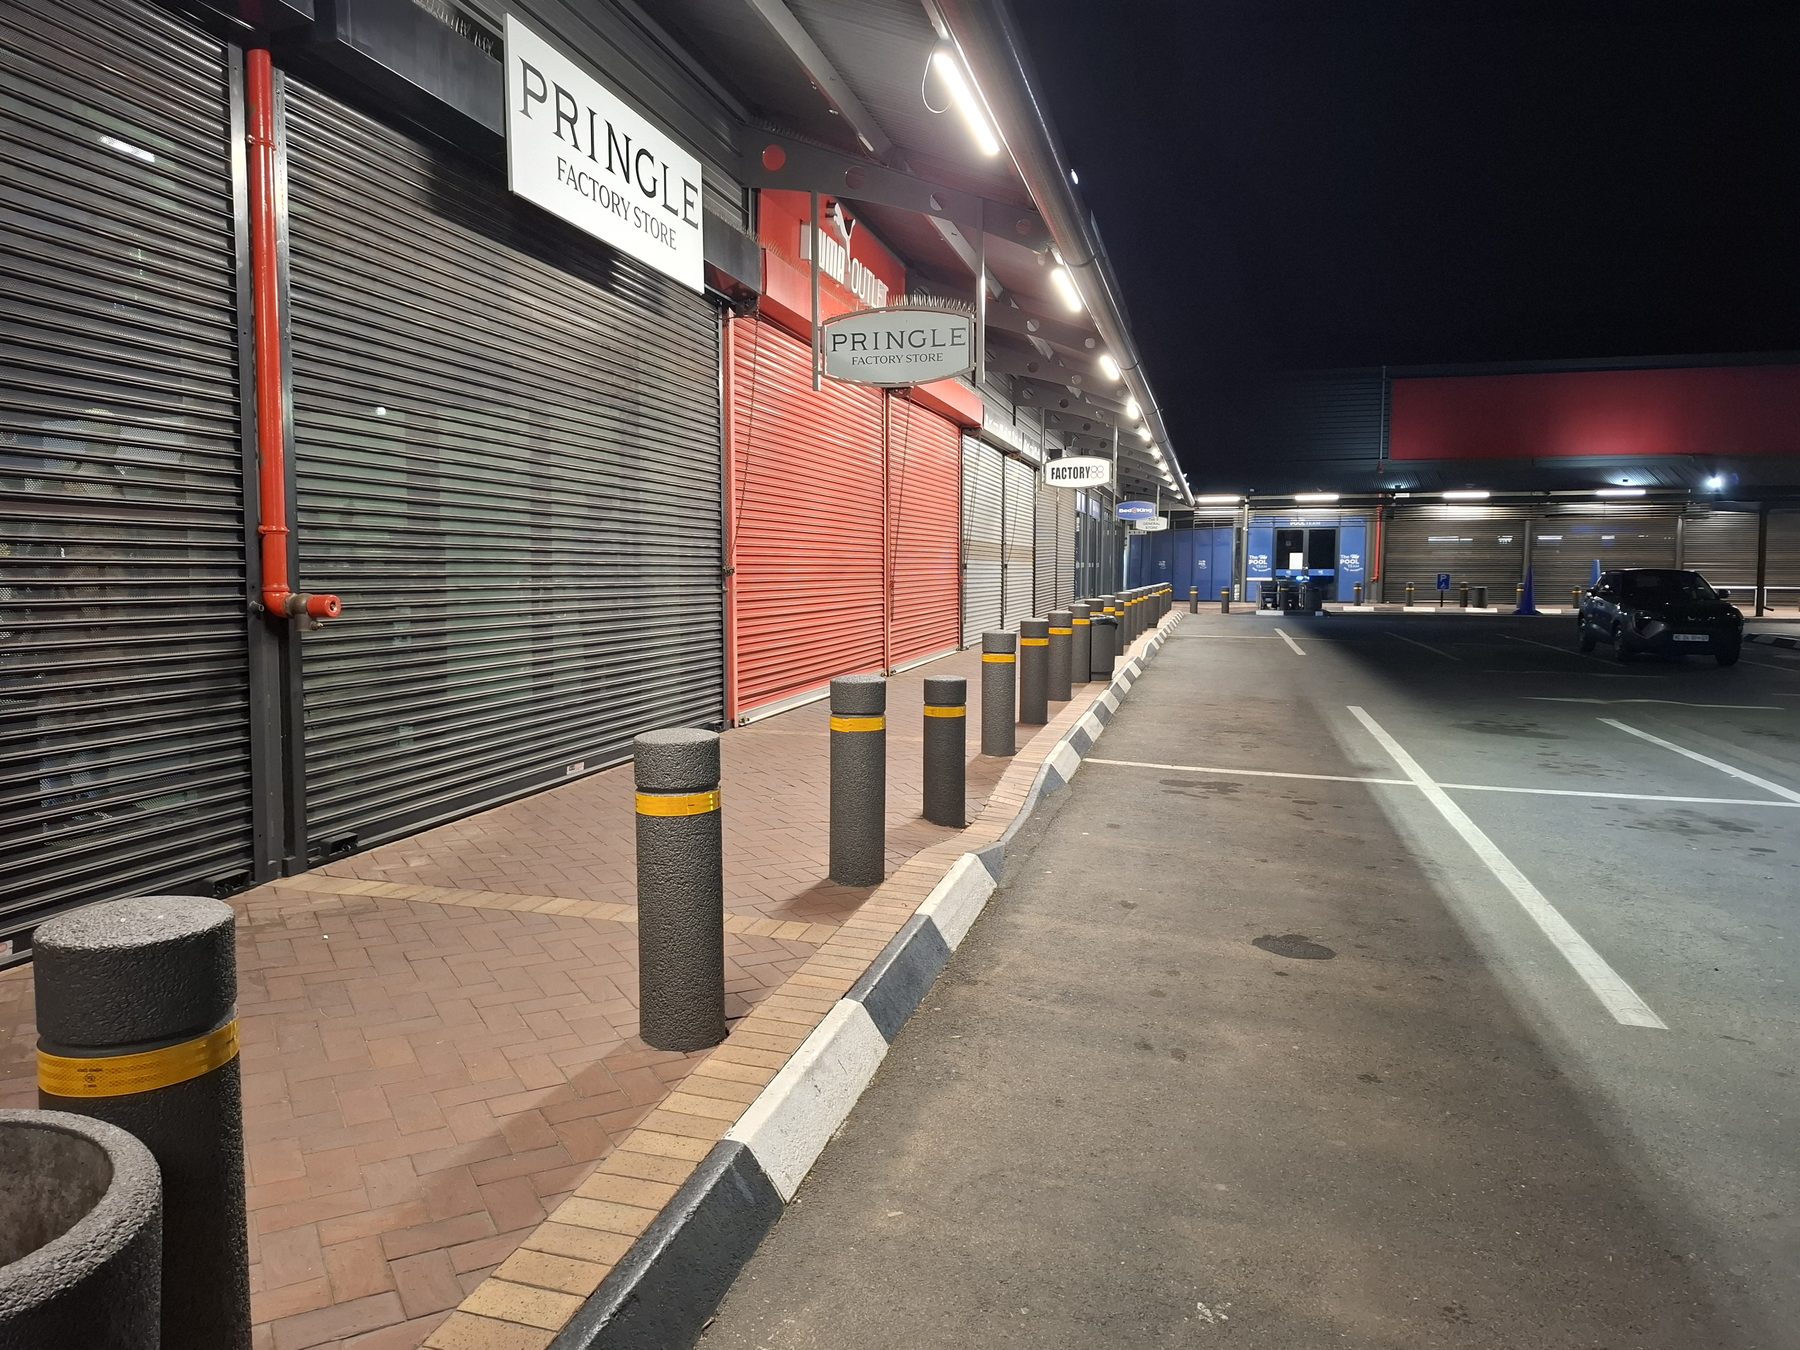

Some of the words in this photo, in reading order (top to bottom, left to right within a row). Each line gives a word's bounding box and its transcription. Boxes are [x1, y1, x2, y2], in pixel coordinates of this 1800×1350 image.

[517, 56, 699, 230] PRINGLE
[557, 155, 631, 221] FACTORY
[633, 206, 677, 251] STORE
[800, 221, 846, 285] UMA
[851, 257, 889, 308] OUTLET
[831, 327, 967, 352] PRINGLE
[851, 353, 904, 366] FACTORY
[906, 352, 944, 363] STORE
